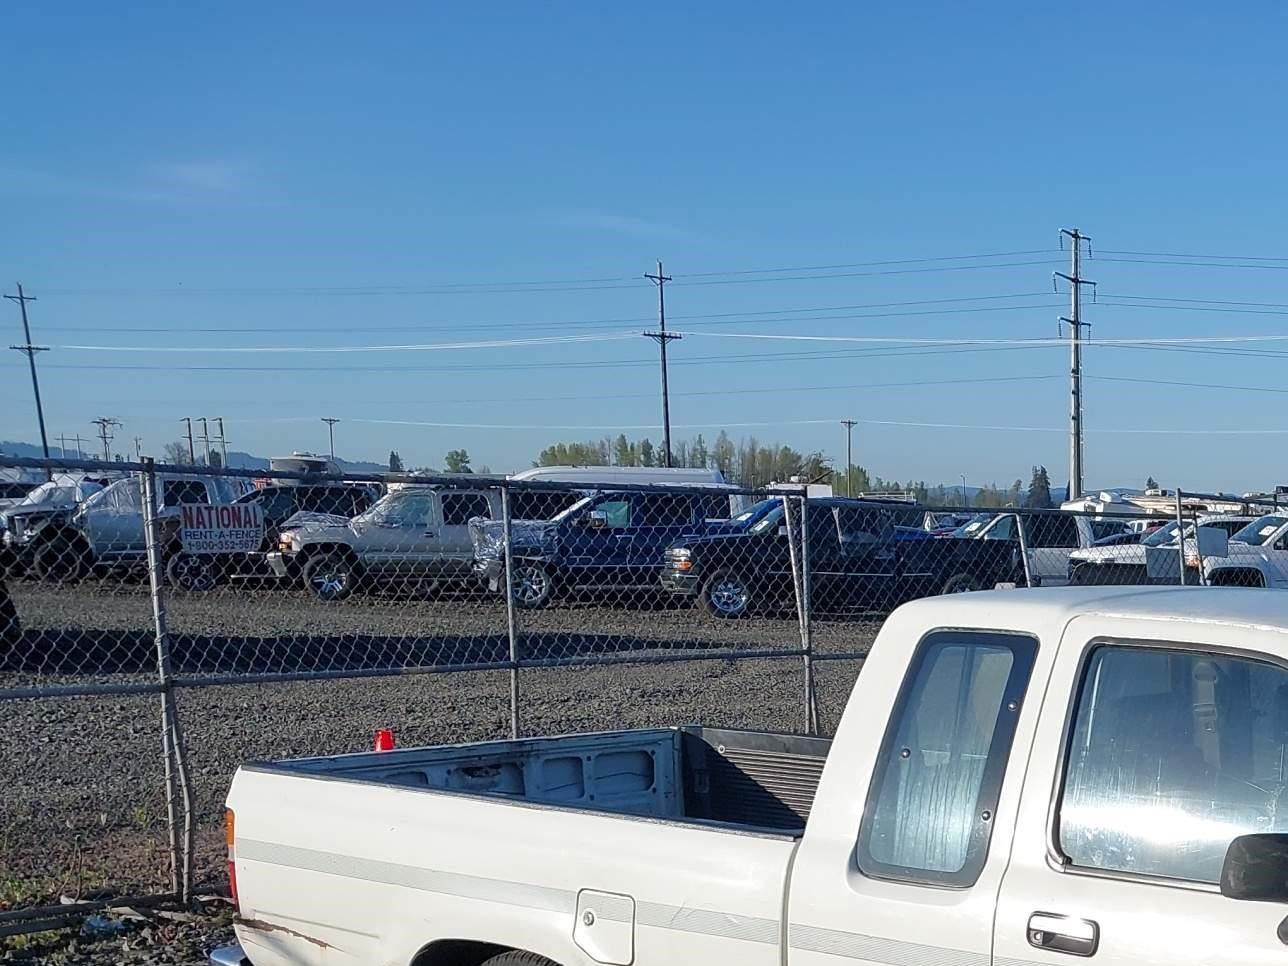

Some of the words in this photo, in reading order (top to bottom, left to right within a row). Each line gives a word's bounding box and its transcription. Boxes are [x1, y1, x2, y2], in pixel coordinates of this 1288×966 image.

[182, 506, 261, 529] NATIONAL
[184, 529, 261, 540] RENT-A-FENCE
[187, 539, 260, 551] 1-800-352-5675
